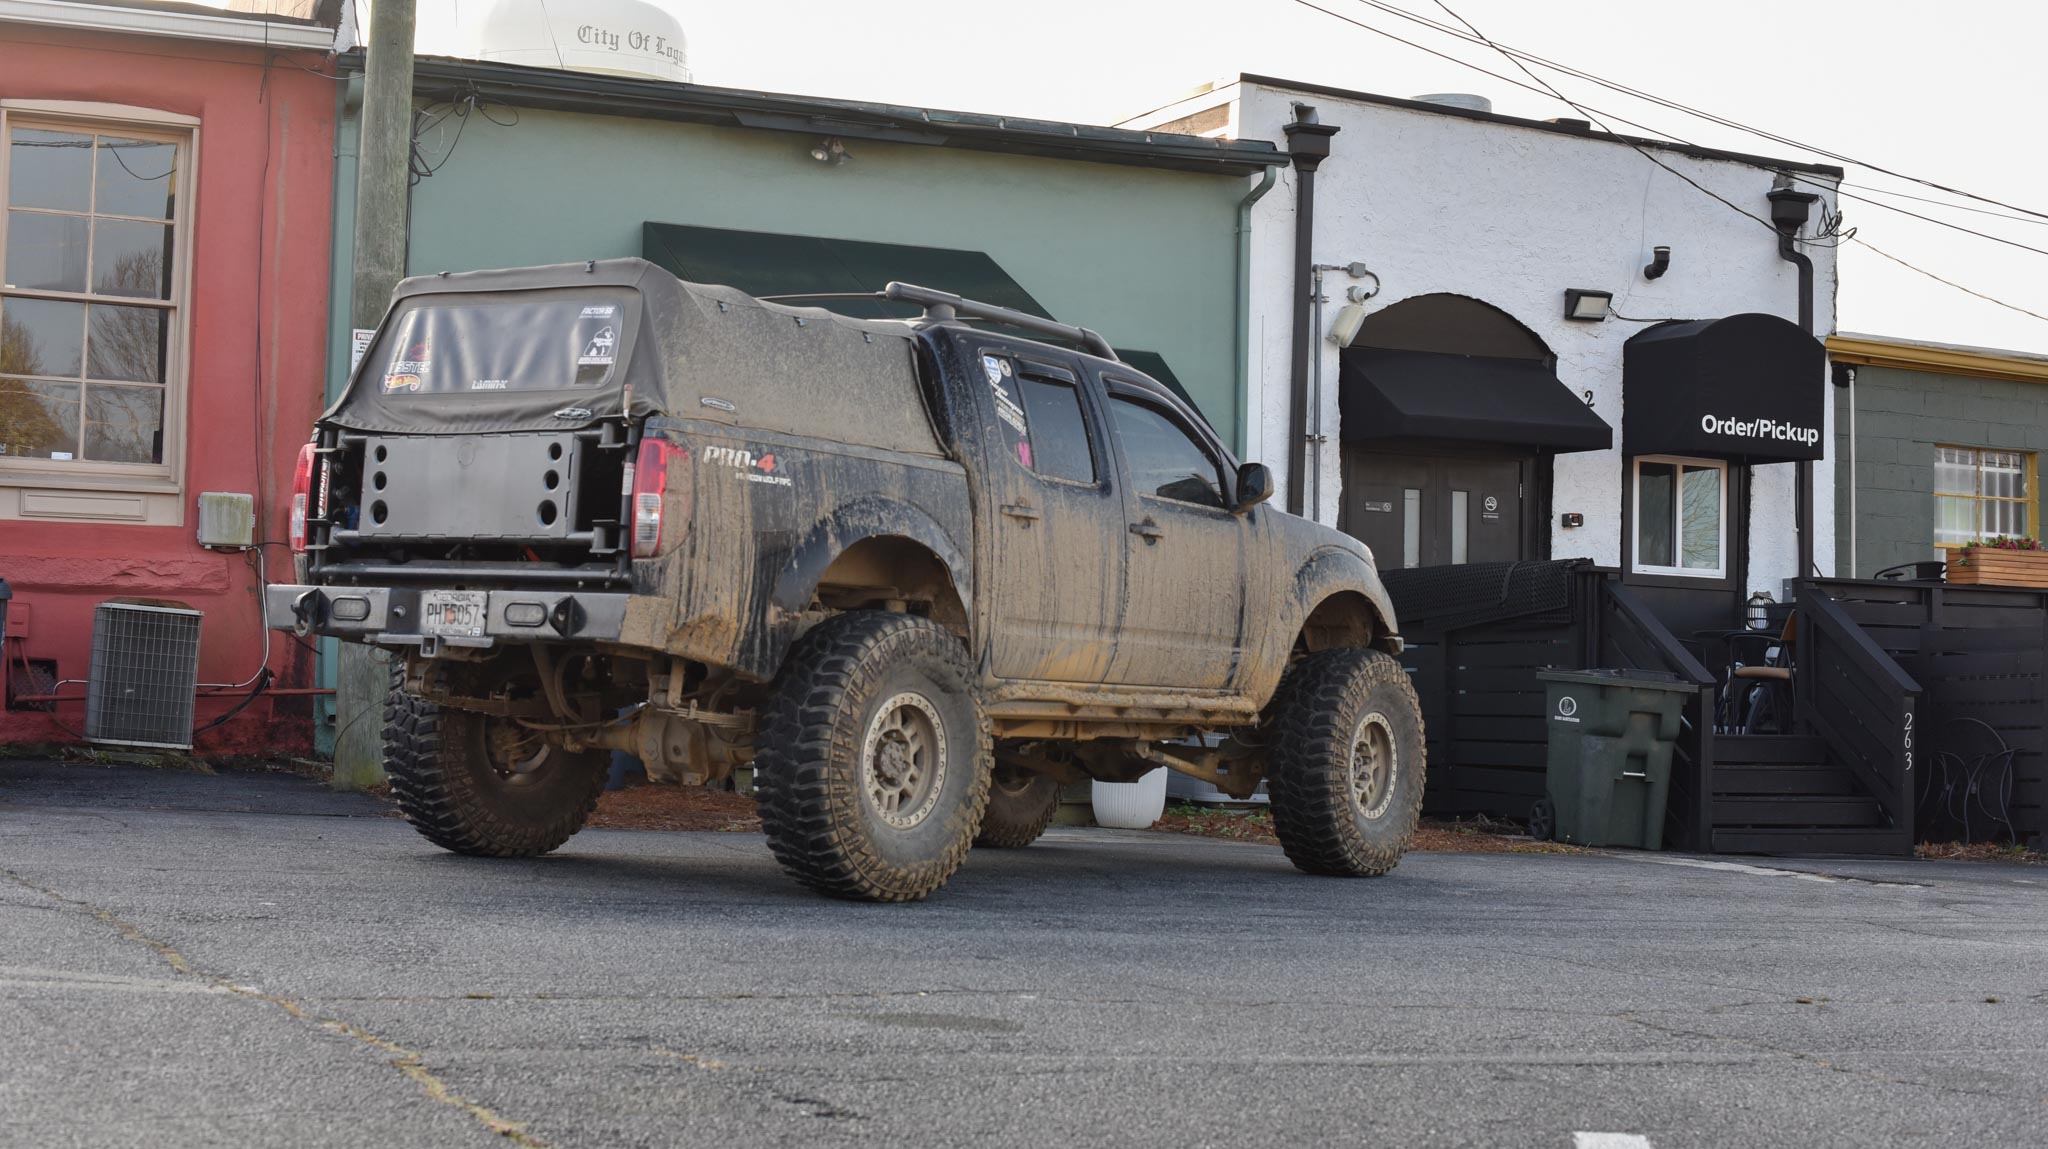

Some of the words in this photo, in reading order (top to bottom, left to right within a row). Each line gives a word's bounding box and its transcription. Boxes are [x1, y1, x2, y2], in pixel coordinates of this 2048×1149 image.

[577, 25, 619, 52] City
[628, 30, 651, 52] Of
[655, 36, 687, 65] Loga
[1702, 414, 1818, 446] Order/Pickup
[436, 592, 471, 602] GEORGIA
[1904, 712, 1913, 771] 263
